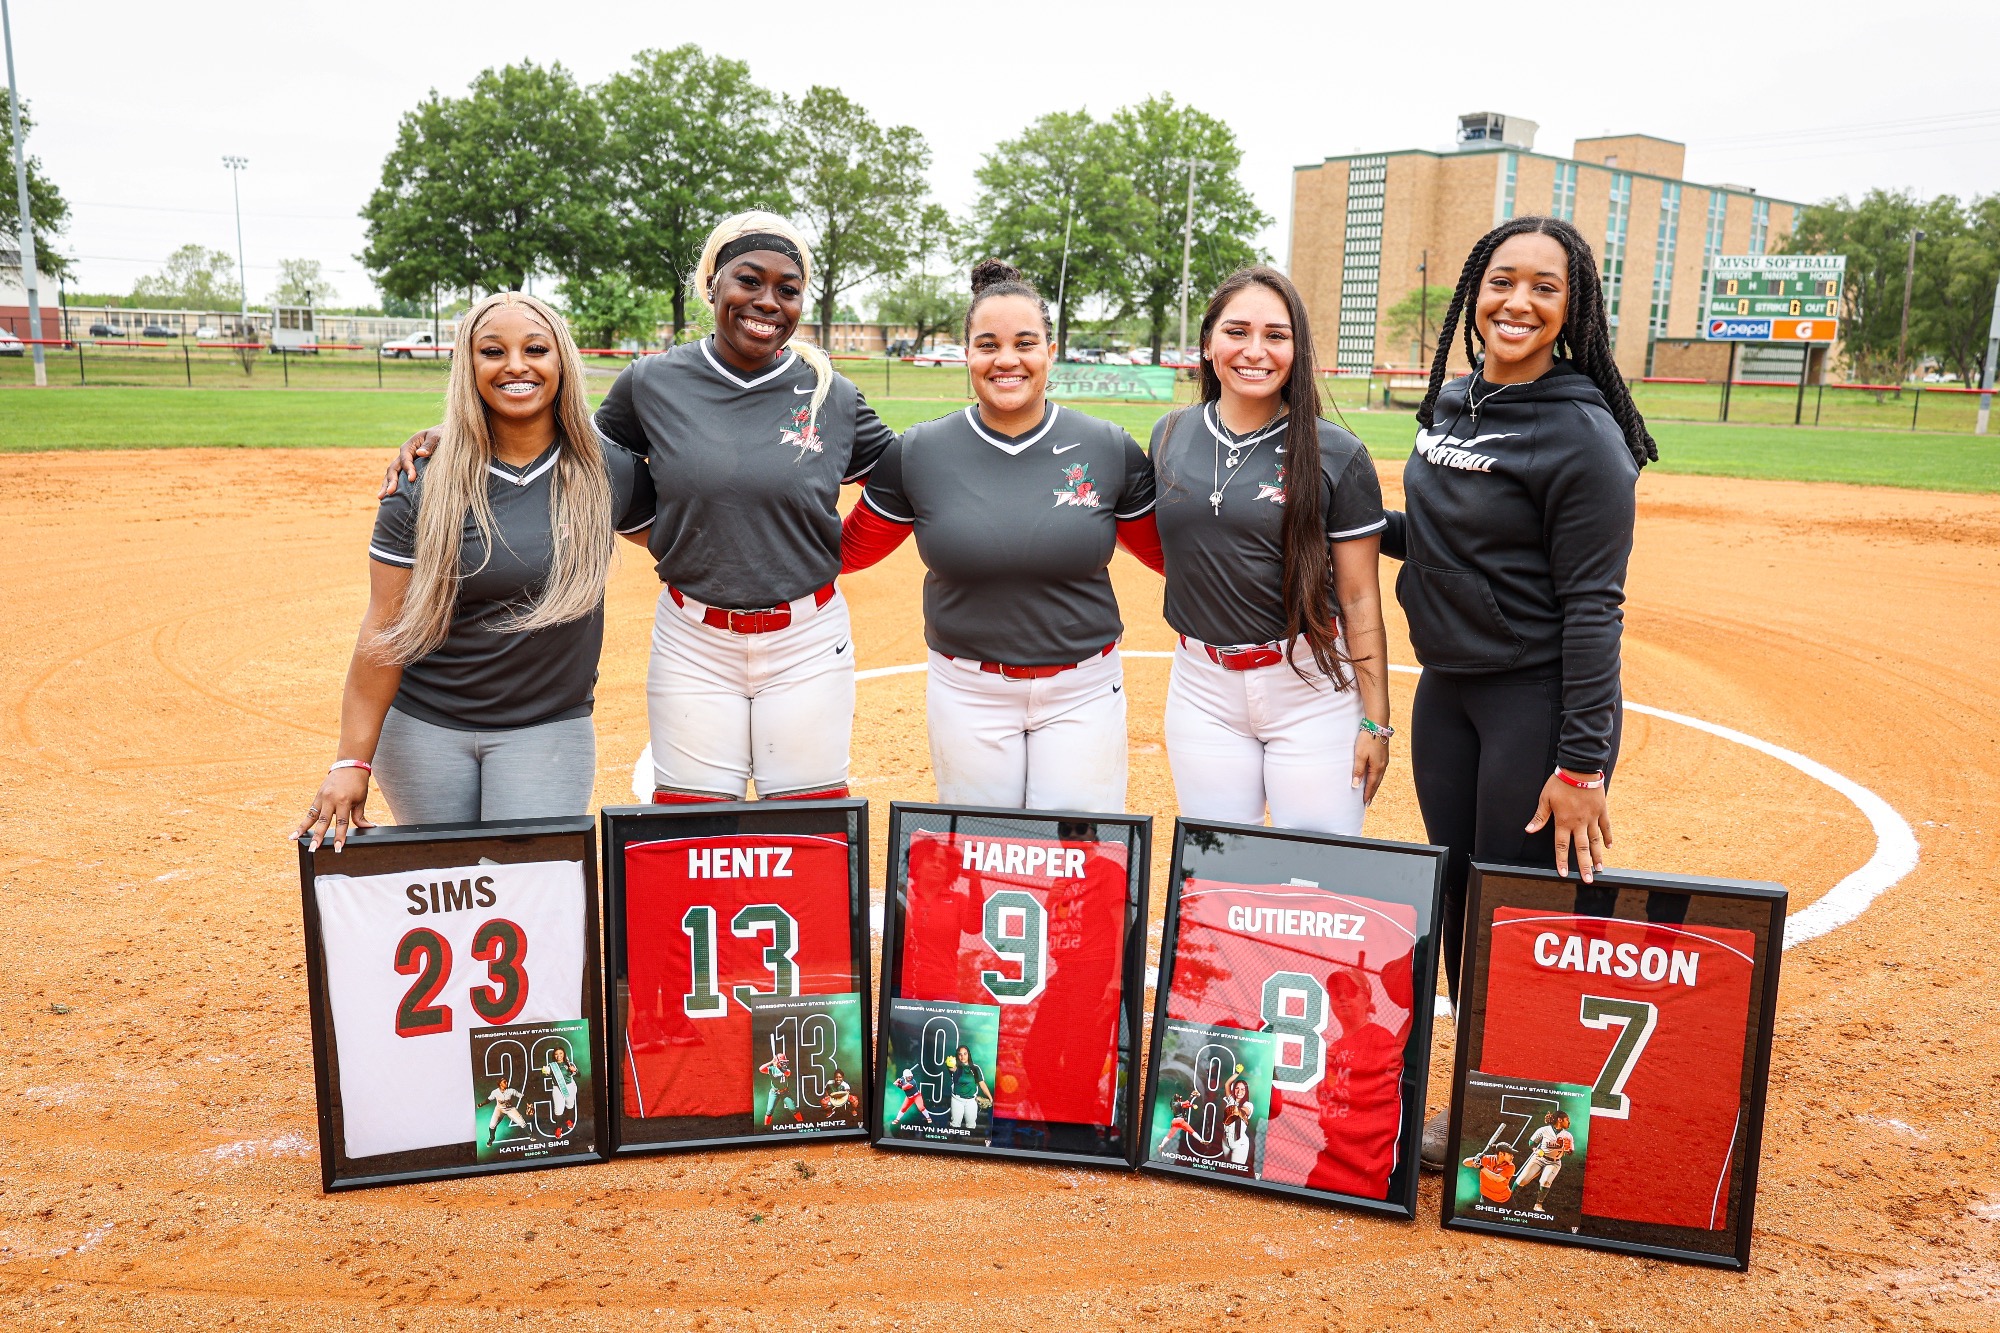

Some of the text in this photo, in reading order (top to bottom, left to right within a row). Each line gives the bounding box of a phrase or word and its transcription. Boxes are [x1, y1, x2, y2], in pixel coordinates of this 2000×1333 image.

[1715, 272, 1838, 281] VISITOR INNING HOME
[1719, 258, 1842, 268] MVSU SOFTBALL
[1712, 302, 1737, 311] BALL
[1755, 303, 1789, 313] STRIKE
[1805, 303, 1826, 313] OUT
[1727, 322, 1769, 336] pepsi
[1796, 322, 1812, 338] G
[688, 846, 793, 879] HENTZ
[962, 840, 1086, 879] HARPER
[406, 876, 497, 916] SIMS
[1227, 905, 1366, 942] GUTIERREZ
[681, 903, 800, 1018] 13
[981, 890, 1048, 1005] 9
[1534, 931, 1700, 987] CARSON
[394, 918, 529, 1038] 23
[1239, 1035, 1272, 1044] UNIVERSITY
[1259, 970, 1330, 1092] 8
[775, 1014, 838, 1109] 13
[920, 1016, 959, 1115] 9
[1579, 993, 1658, 1120] 7
[485, 1036, 578, 1143] 23
[1186, 1044, 1236, 1159] 8
[1549, 1089, 1585, 1098] UNIVERSITY
[772, 1122, 815, 1131] KAHLENA
[900, 1124, 971, 1136] KAITLYN HARPER
[1500, 1095, 1560, 1177] 7
[499, 1142, 546, 1154] KATHLEEN
[1161, 1152, 1249, 1172] MORGAN GUTIERREZ
[1475, 1205, 1554, 1221] SHELBY CARSON
